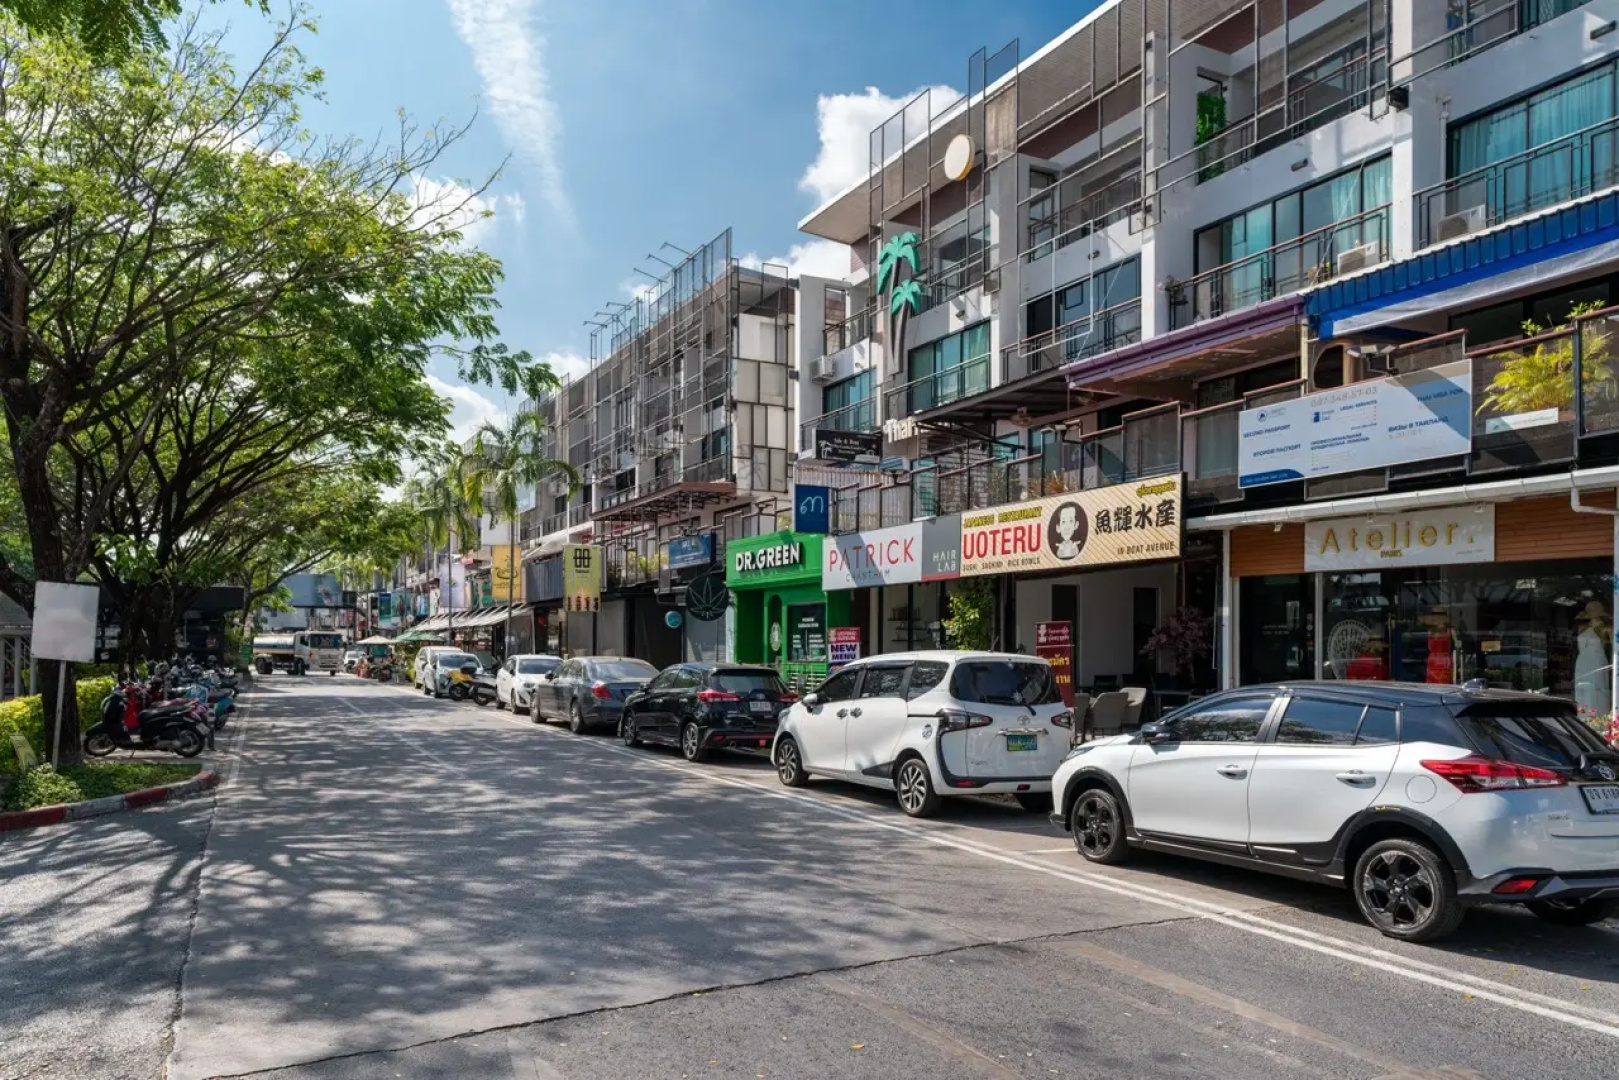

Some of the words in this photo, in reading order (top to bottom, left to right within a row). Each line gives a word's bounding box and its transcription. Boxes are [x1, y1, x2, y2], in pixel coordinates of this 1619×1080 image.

[1264, 424, 1291, 434] PASSPORT
[963, 523, 1042, 560] UOTERU
[1126, 544, 1144, 555] BOAT
[1145, 540, 1175, 552] AVENUE
[735, 542, 801, 571] DR.GREEN
[829, 537, 915, 572] PATRICK
[932, 549, 957, 562] HAIR
[937, 560, 957, 573] LAB
[830, 644, 857, 653] NEW
